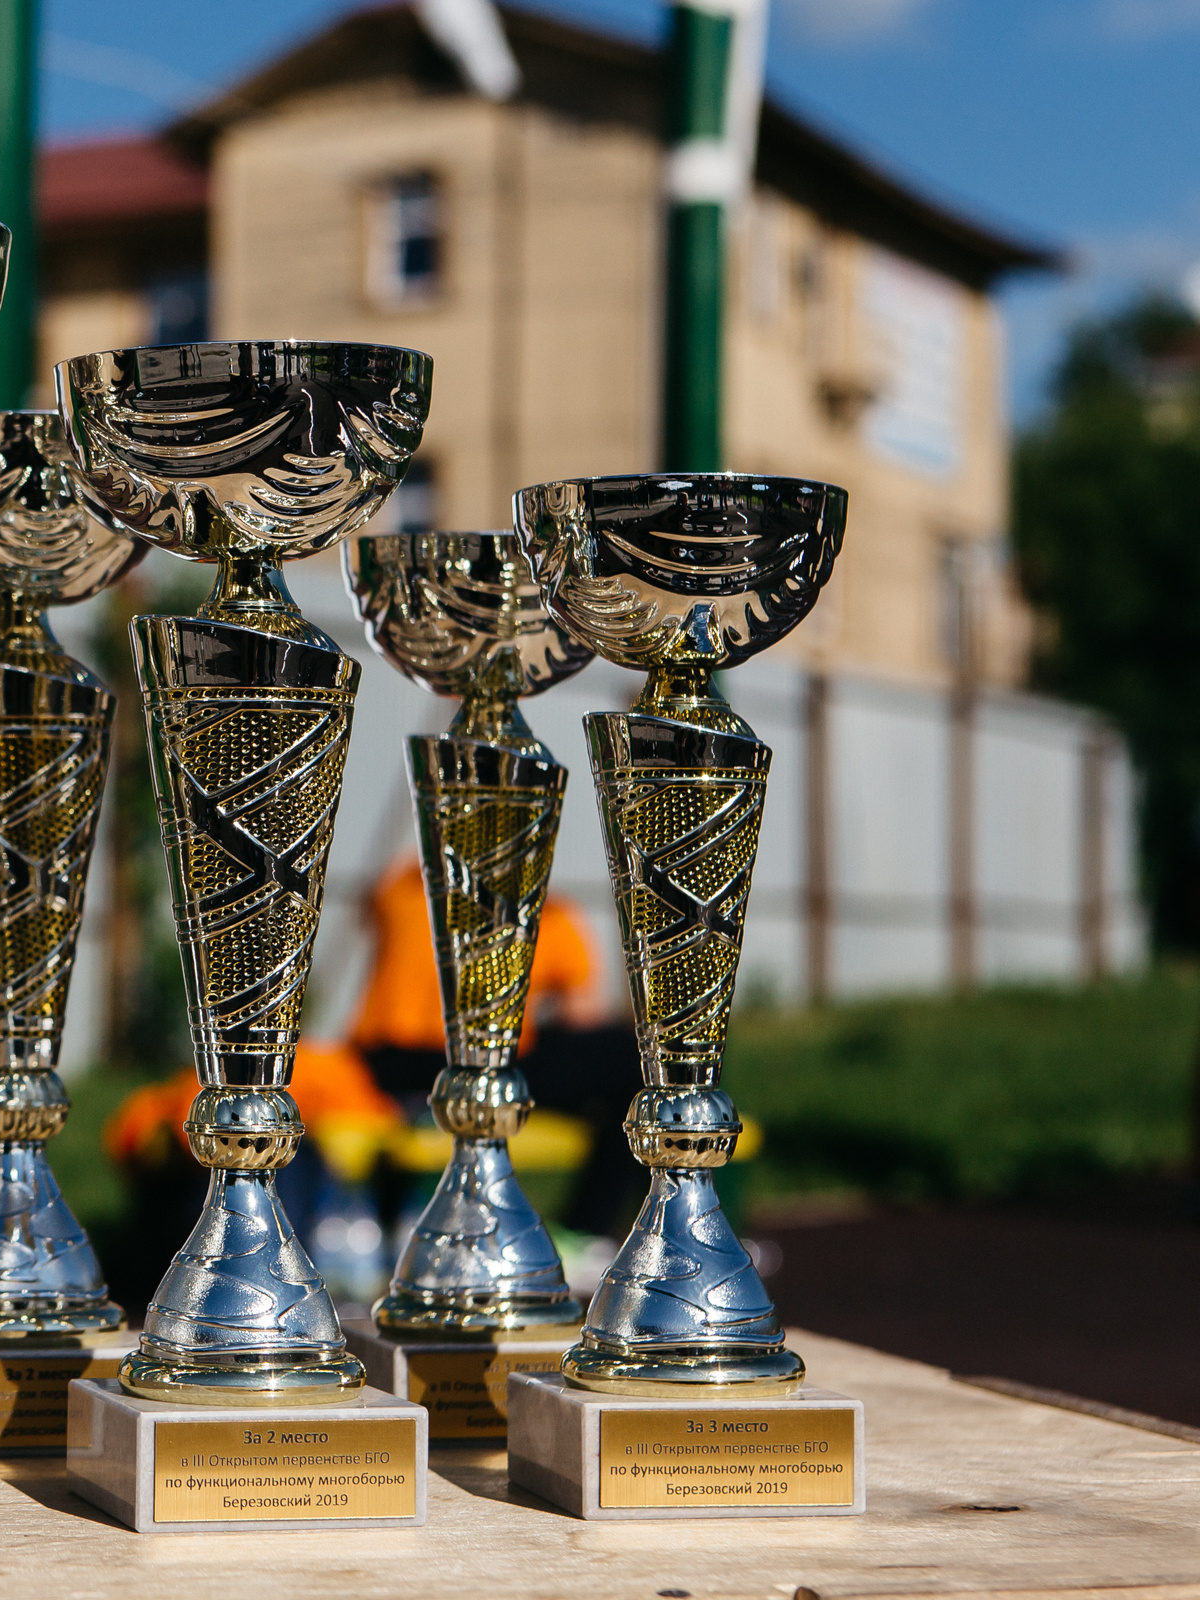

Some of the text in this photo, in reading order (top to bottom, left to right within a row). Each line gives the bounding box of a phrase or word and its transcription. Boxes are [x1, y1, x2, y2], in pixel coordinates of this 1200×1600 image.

[26, 1367, 34, 1380] 2
[686, 1420, 768, 1433] За 3 место
[244, 1431, 328, 1444] За 2 место
[626, 1442, 828, 1456] в III Открытом первенстве БГО
[182, 1452, 390, 1468] в III Открытом первенстве БГО
[610, 1462, 842, 1477] по функциональному многоборью
[166, 1472, 404, 1490] по функциональному многоборью
[667, 1482, 788, 1497] Березовский 2019
[224, 1494, 348, 1510] Березовский 2019
